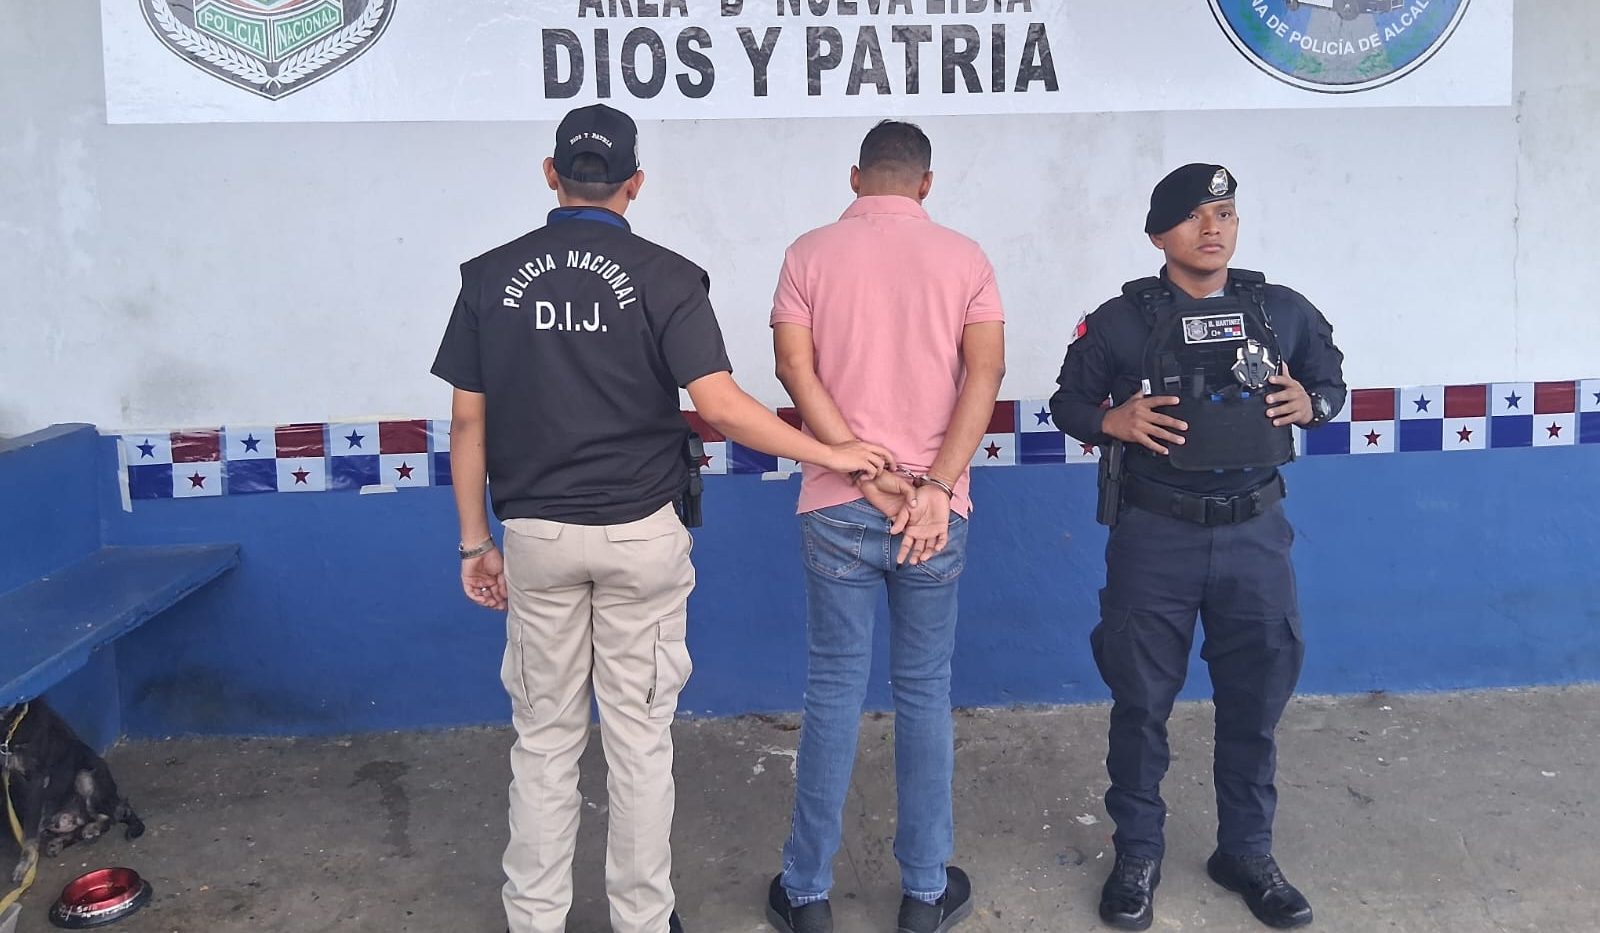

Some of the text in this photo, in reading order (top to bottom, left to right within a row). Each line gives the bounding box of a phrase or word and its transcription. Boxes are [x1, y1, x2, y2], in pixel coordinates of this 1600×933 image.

[203, 10, 336, 50] POLICIA NACIONAL
[1266, 14, 1289, 38] DE
[1289, 31, 1355, 56] POLICÍA
[1358, 33, 1382, 52] DE
[541, 23, 1060, 99] DIOS Y PATRIA
[503, 250, 637, 310] POLICIA NACIONAL
[535, 301, 608, 332] D.I.J.
